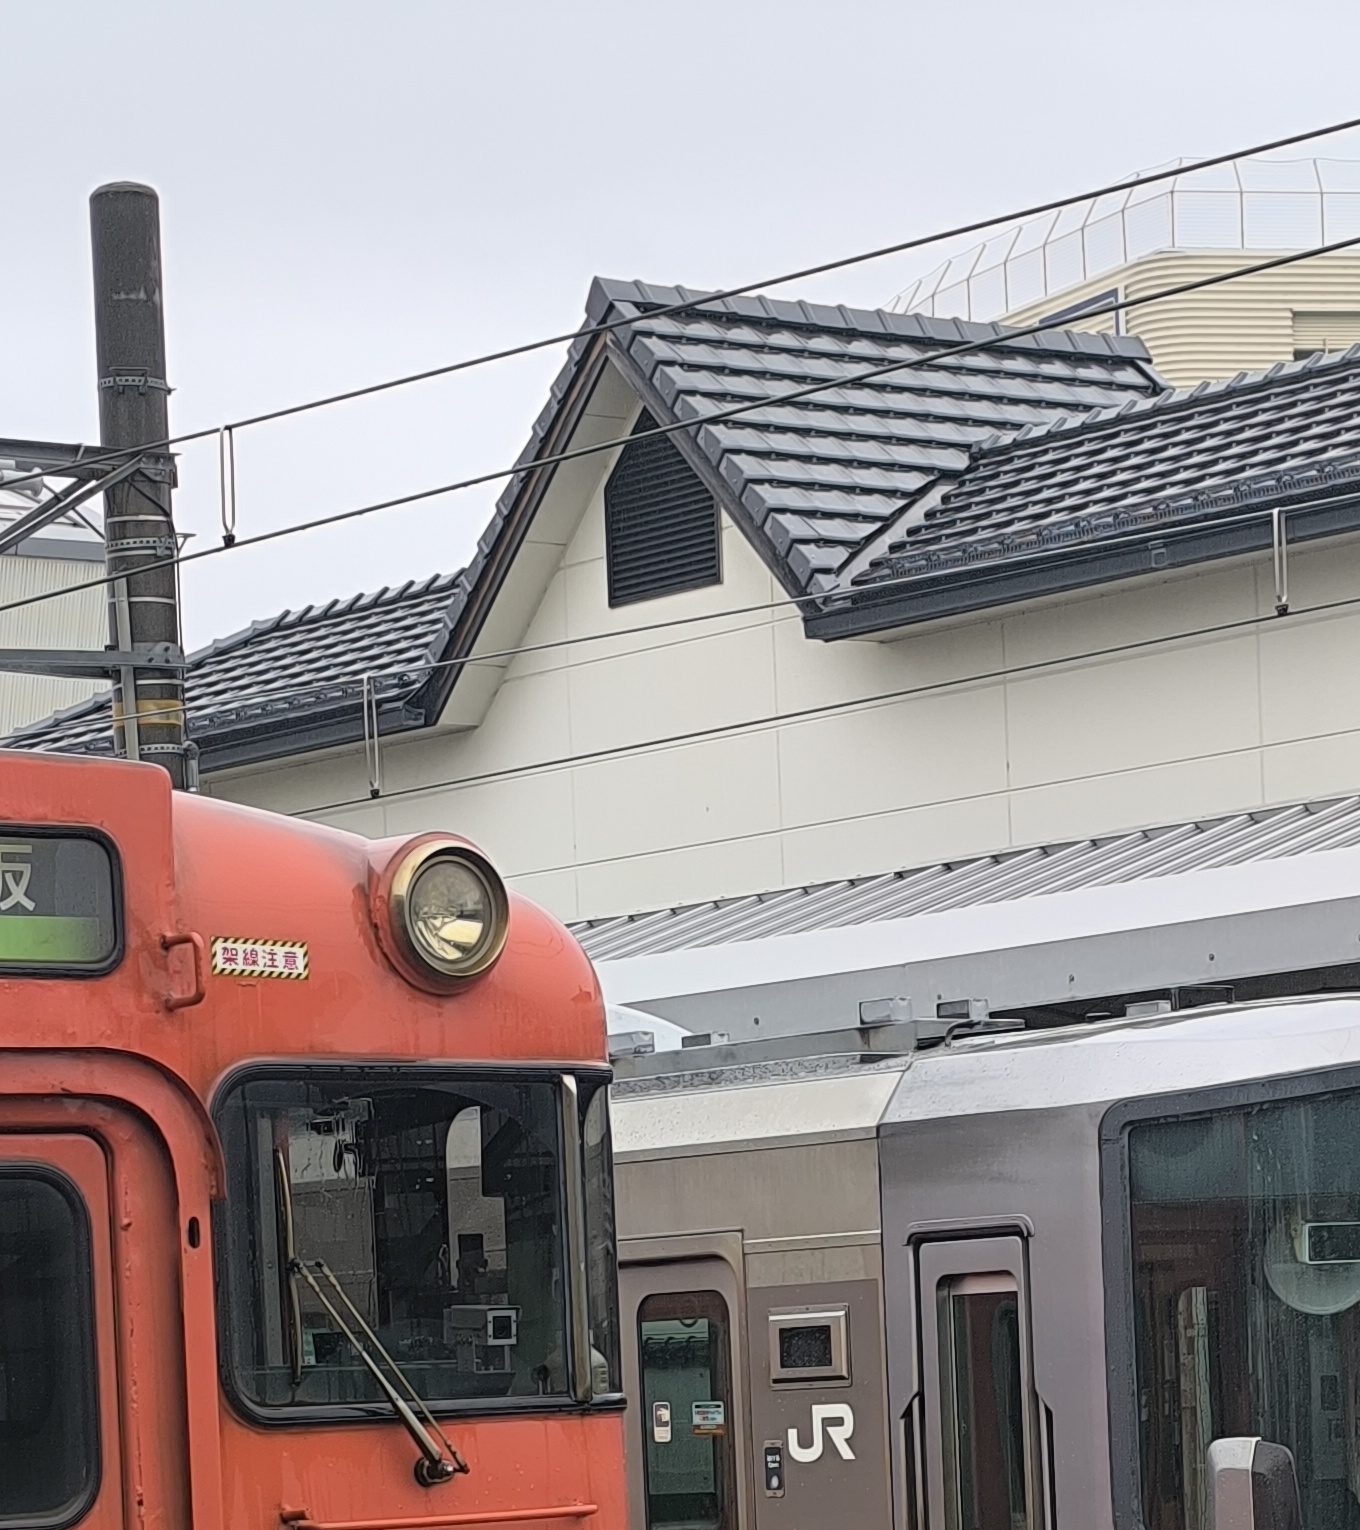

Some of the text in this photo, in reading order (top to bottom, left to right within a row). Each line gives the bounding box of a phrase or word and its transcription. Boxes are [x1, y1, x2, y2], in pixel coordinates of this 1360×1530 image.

[221, 946, 300, 971] 架線注意
[787, 1403, 857, 1463] JR
